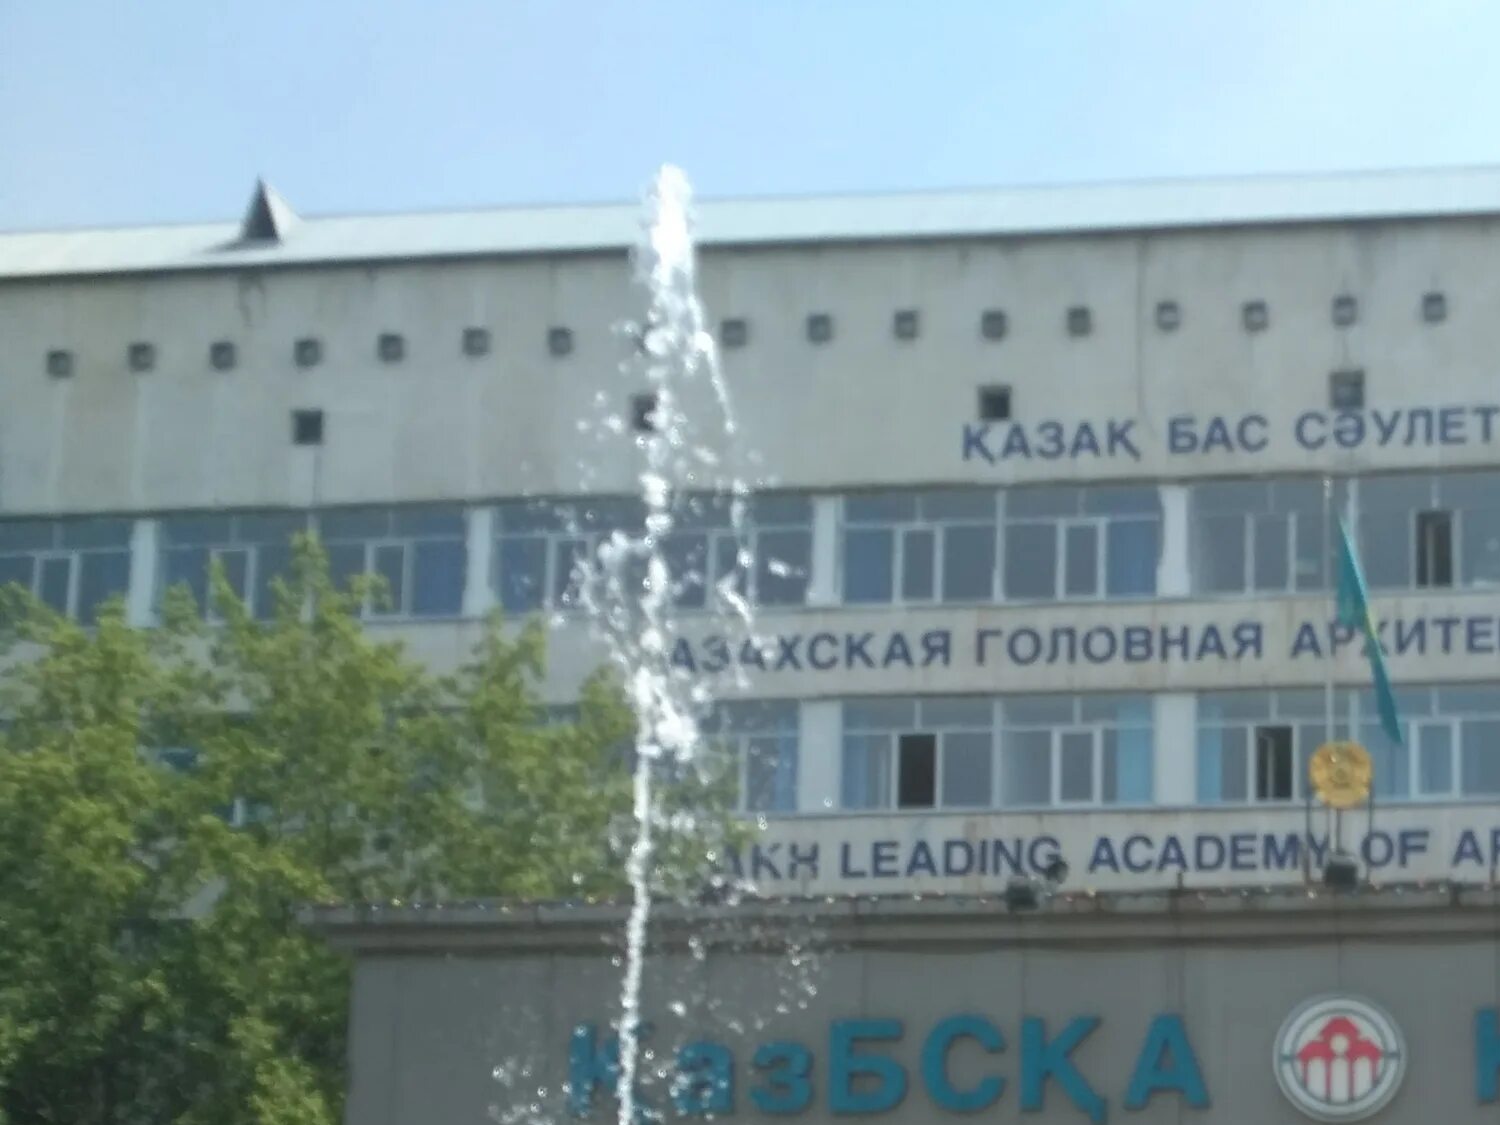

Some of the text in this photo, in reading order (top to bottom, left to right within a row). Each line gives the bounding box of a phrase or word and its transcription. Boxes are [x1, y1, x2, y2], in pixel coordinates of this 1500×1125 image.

[962, 418, 1141, 464] ҚАЗАҚ
[1168, 414, 1268, 454] БАС
[640, 630, 953, 673] АЗАХСКАЯ
[975, 622, 1264, 667] ГОЛОВНАЯ
[840, 837, 1060, 879] LEADING
[1087, 831, 1331, 874] ACADEMY
[1360, 829, 1430, 868] OF
